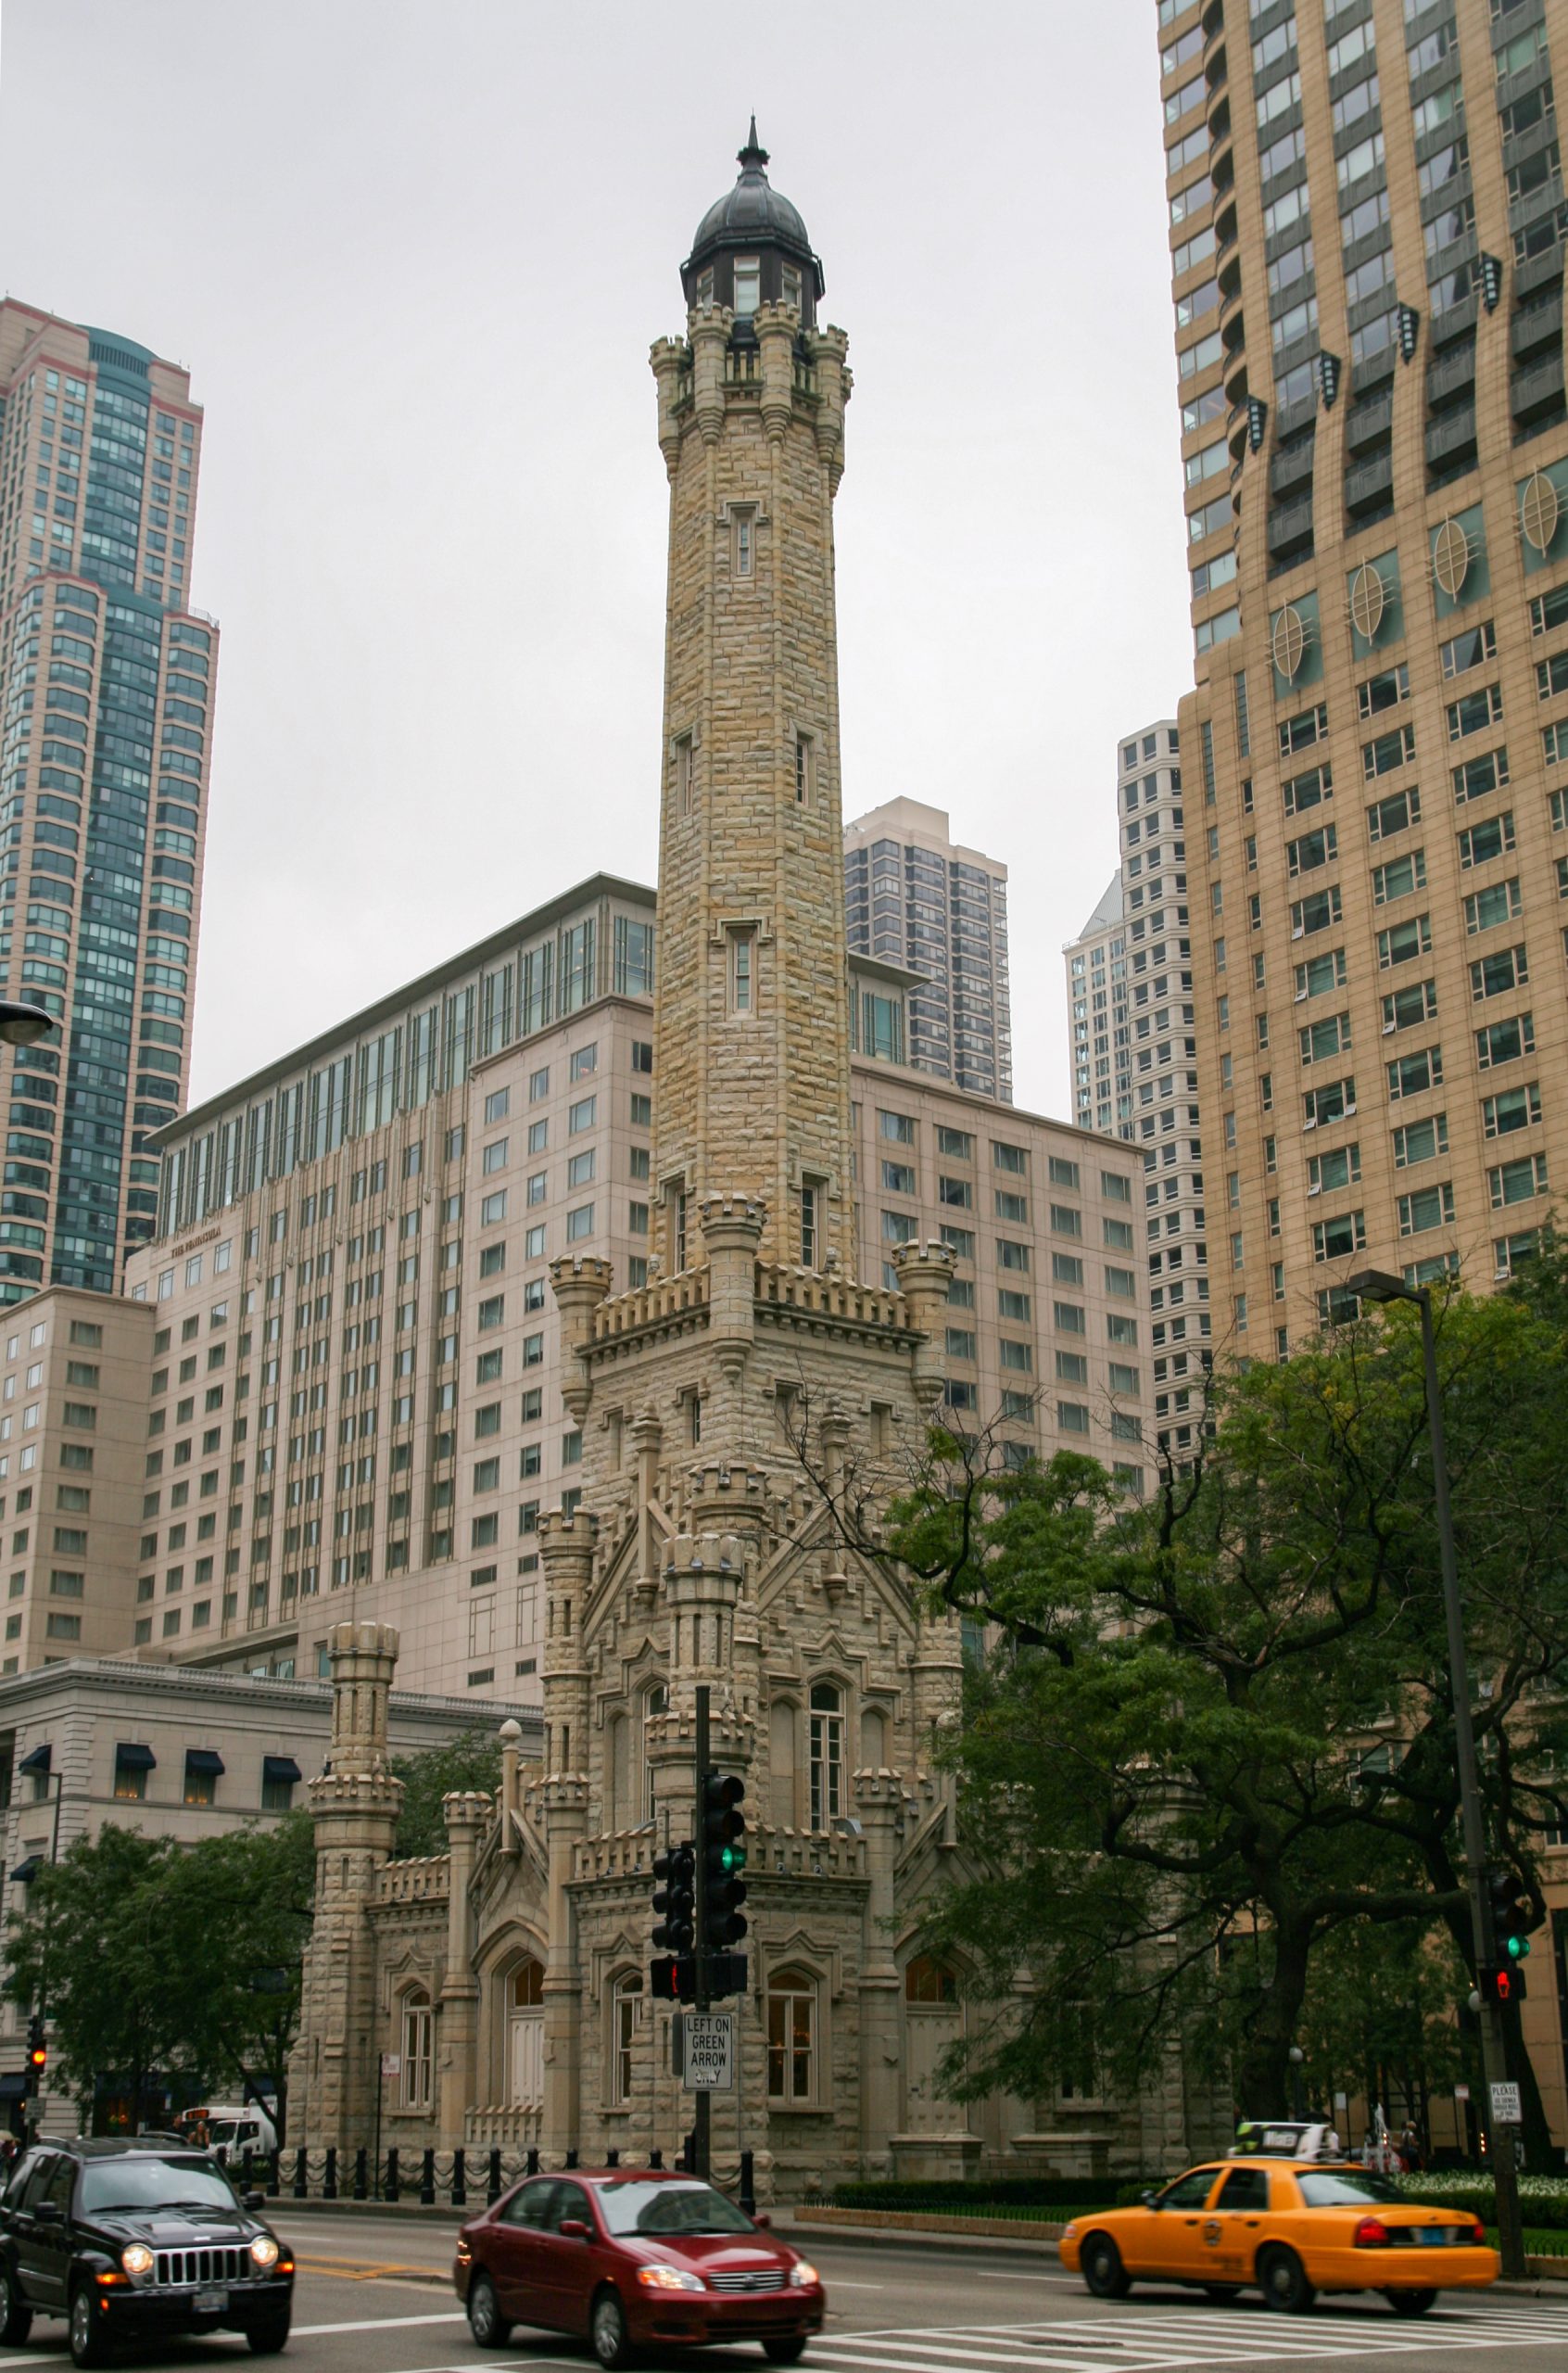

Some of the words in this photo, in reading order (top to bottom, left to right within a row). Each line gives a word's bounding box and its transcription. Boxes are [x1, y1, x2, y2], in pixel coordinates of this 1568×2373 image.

[171, 1244, 183, 1259] THE
[186, 1225, 221, 1252] PENINSULA
[687, 2017, 712, 2032] LEFT
[715, 2018, 729, 2032] ON
[692, 2035, 725, 2049] GREEN
[690, 2051, 727, 2066] ARROW
[1492, 2086, 1517, 2096] PLEASE
